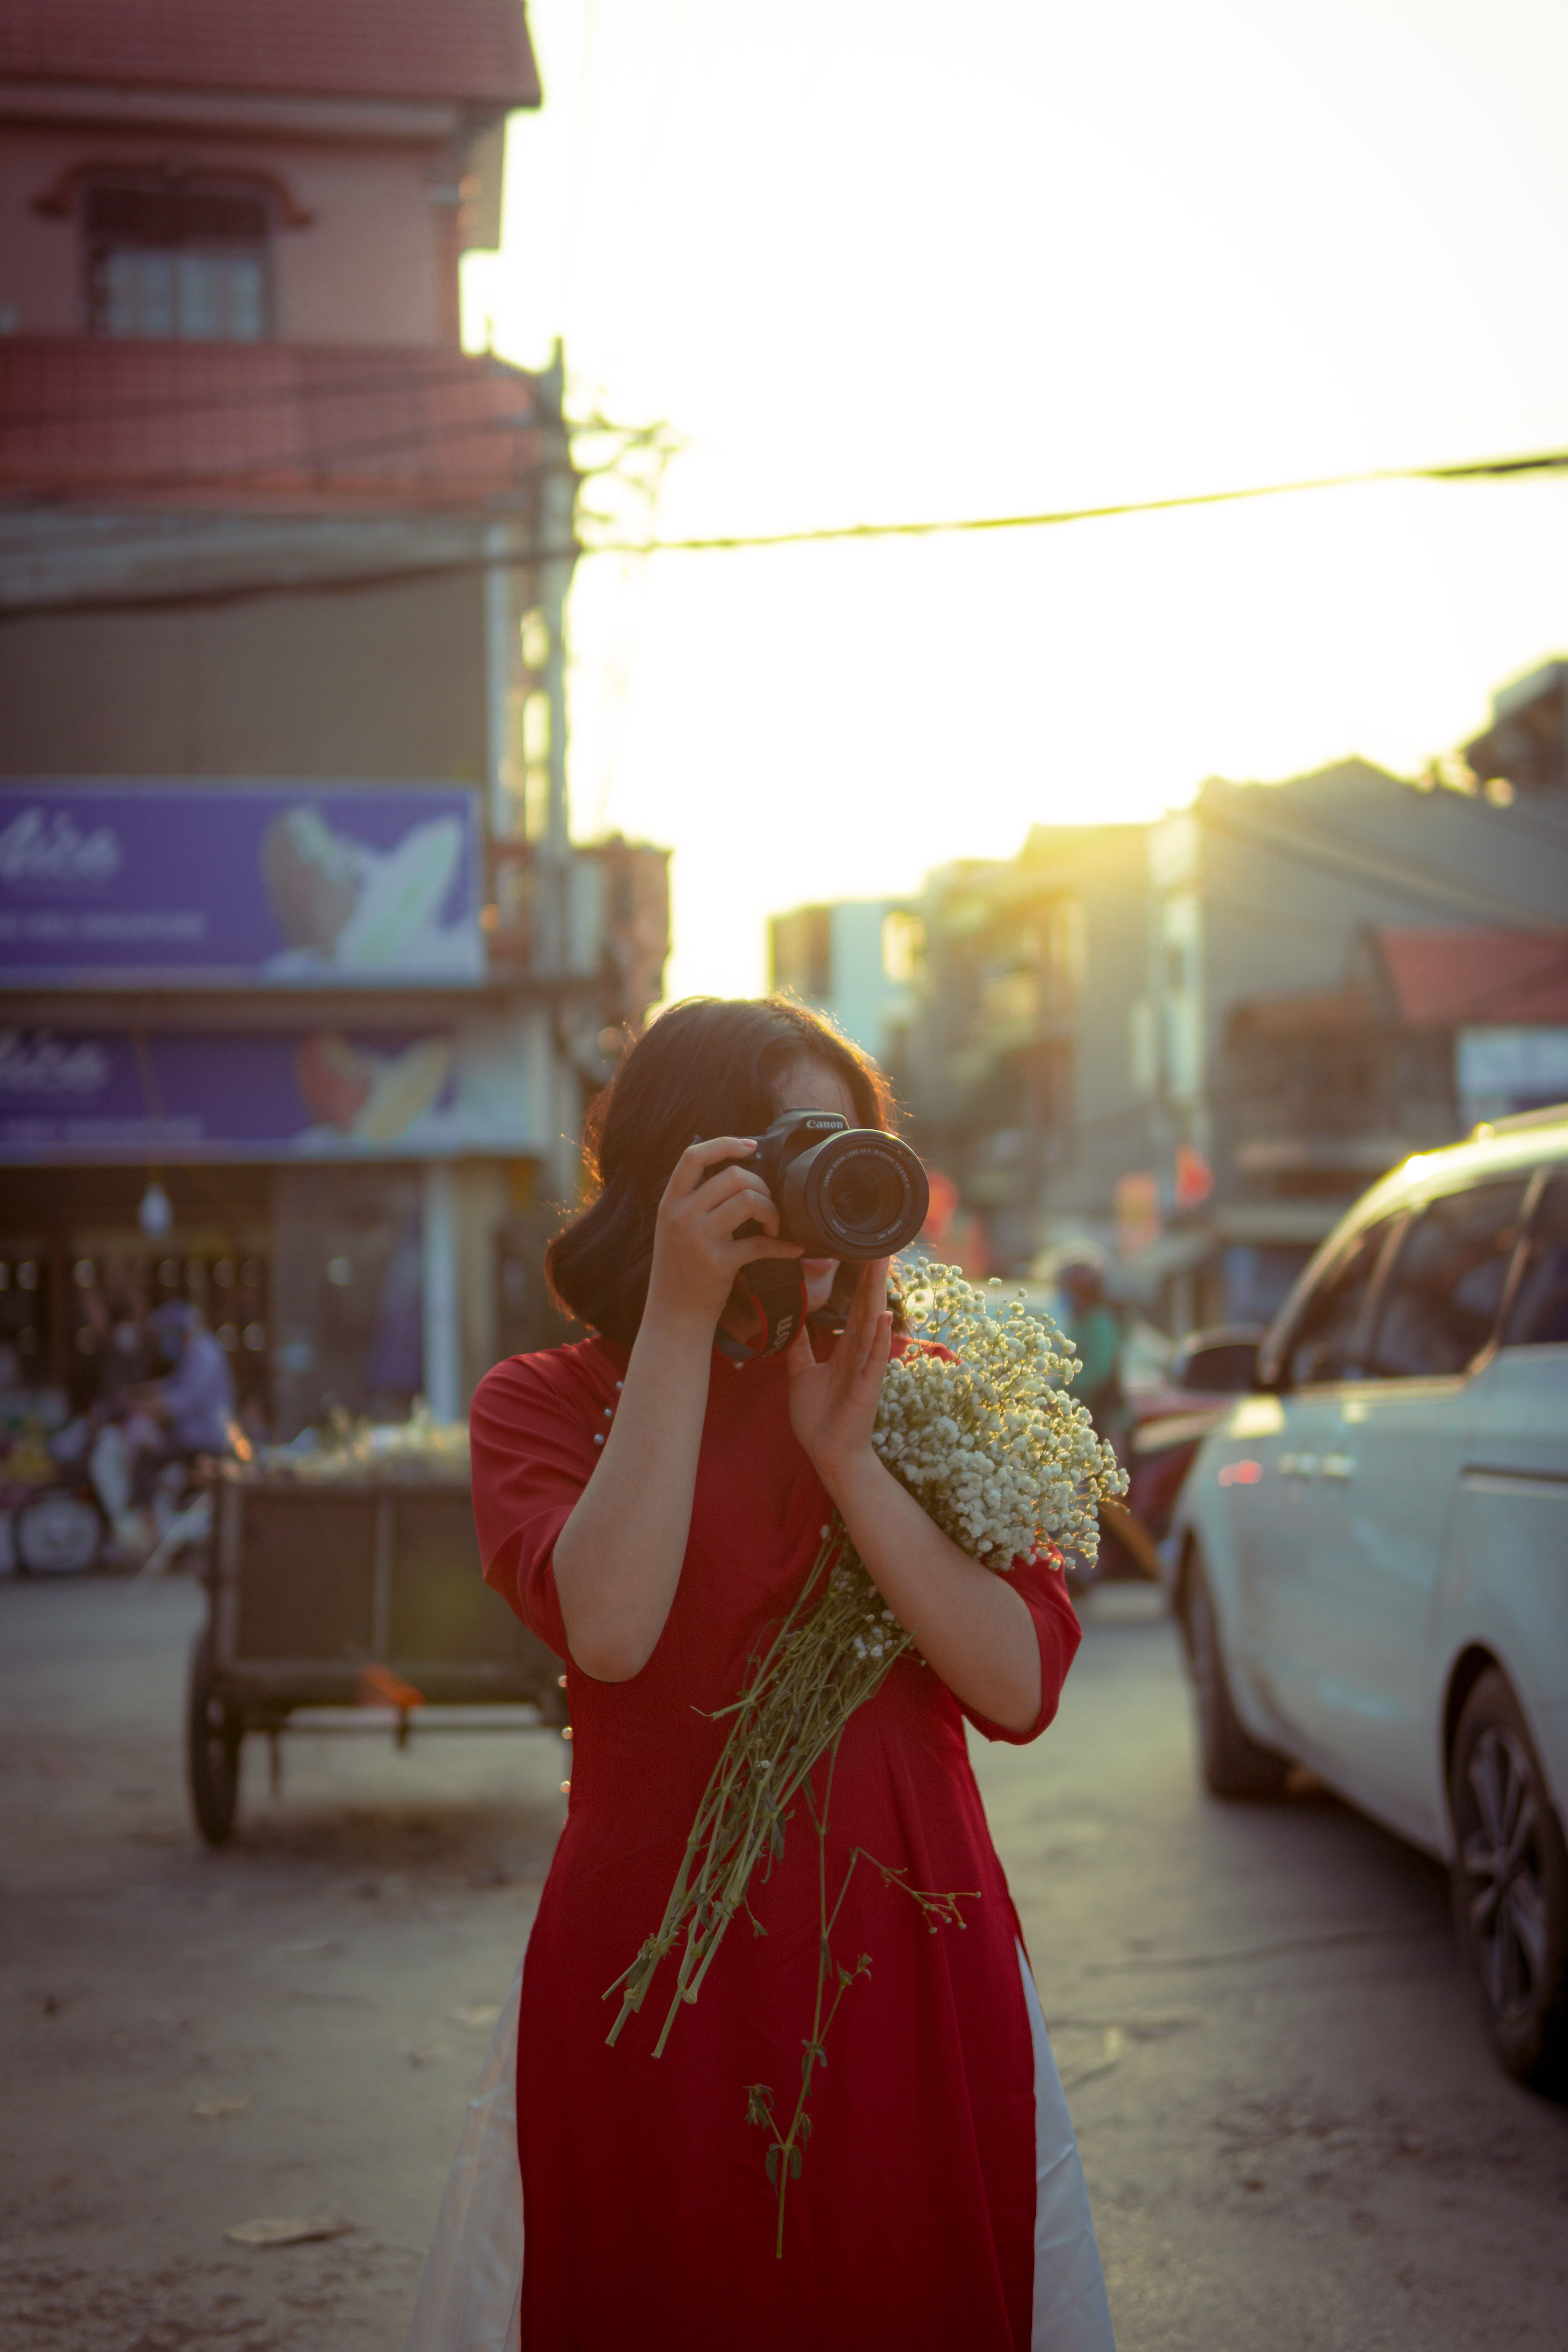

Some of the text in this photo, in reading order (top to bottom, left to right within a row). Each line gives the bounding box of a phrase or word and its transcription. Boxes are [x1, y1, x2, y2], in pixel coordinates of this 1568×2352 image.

[806, 1120, 843, 1128] Canon
[824, 1169, 833, 1186] CANON
[833, 1156, 846, 1168] ZOOM
[874, 1149, 894, 1162] 18-135mm
[887, 1221, 902, 1234] CANON
